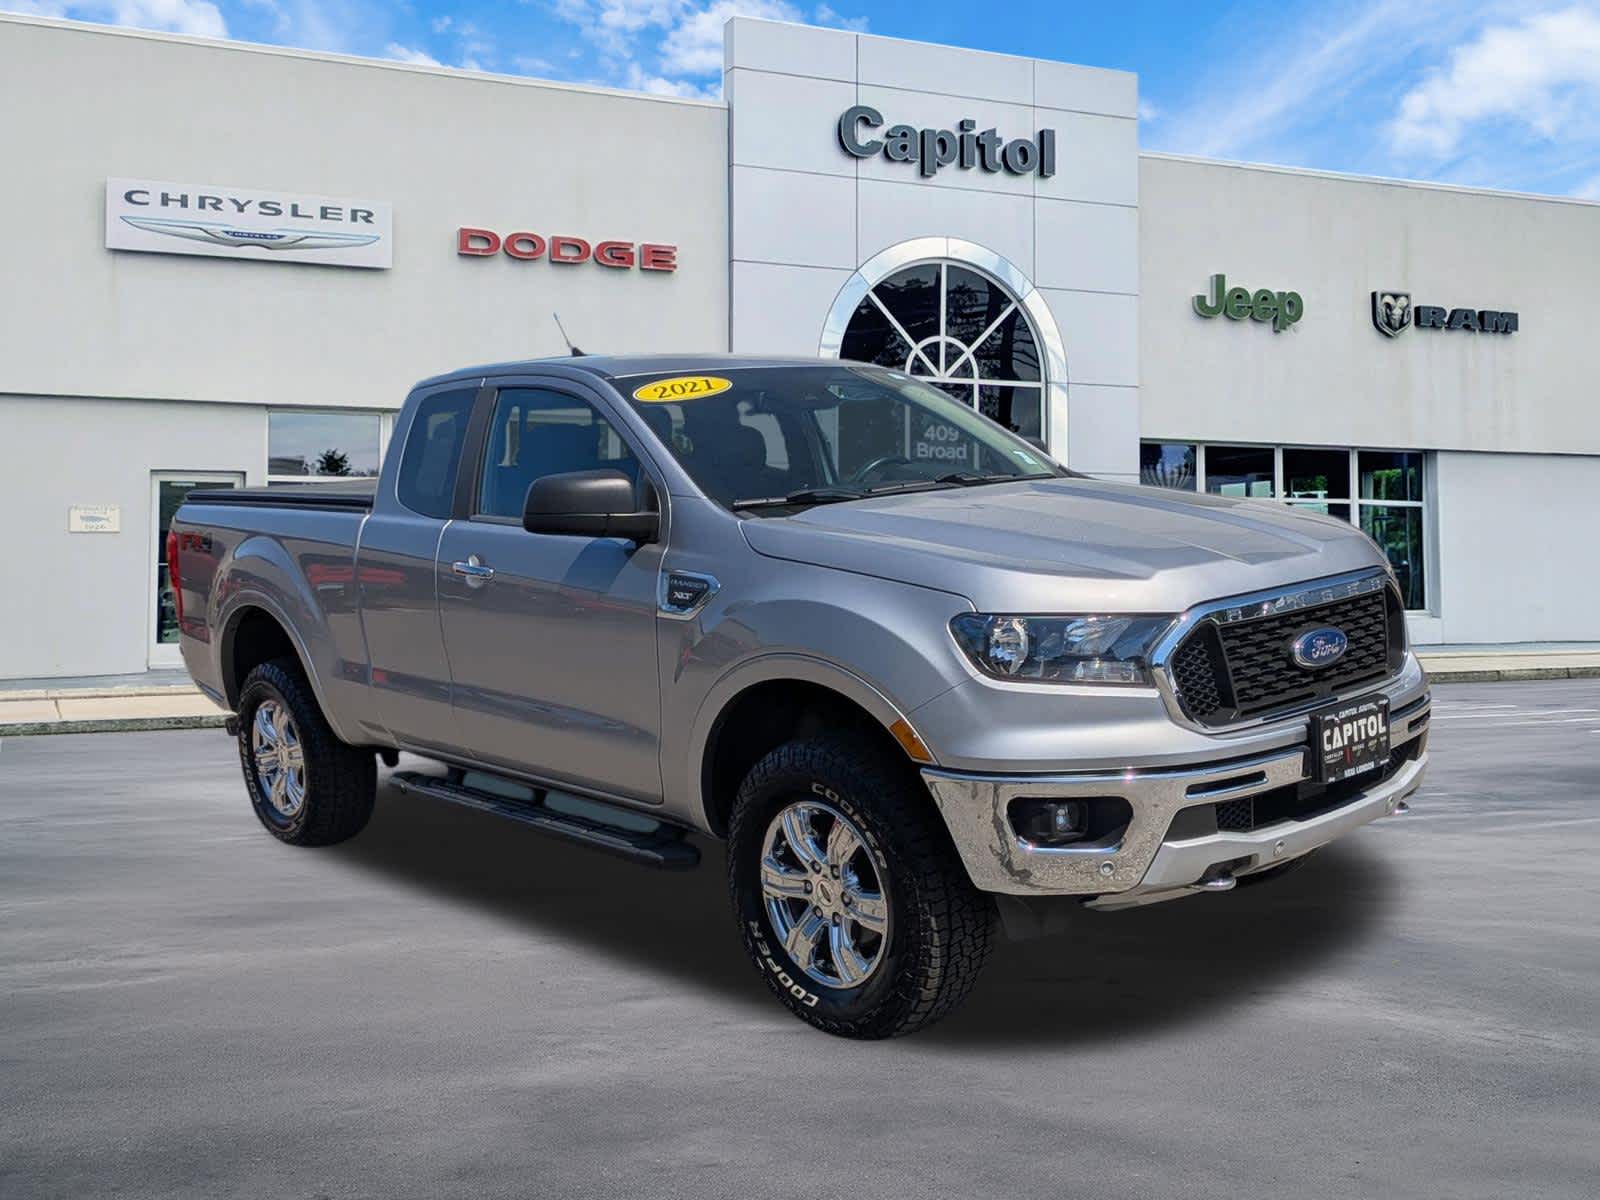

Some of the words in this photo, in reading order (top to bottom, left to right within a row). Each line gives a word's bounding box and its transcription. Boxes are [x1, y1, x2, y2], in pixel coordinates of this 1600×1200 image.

[838, 105, 1056, 178] Capitol
[123, 189, 376, 224] CHRYSLER
[457, 226, 678, 272] DODGE
[1192, 273, 1304, 333] Jeep
[1413, 304, 1519, 334] RAM
[652, 379, 714, 399] 2021
[916, 441, 968, 460] Broad
[923, 424, 960, 441] 409
[1322, 713, 1387, 751] CAPITOL
[811, 782, 888, 869] COOPER
[749, 920, 819, 1007] COOPER
